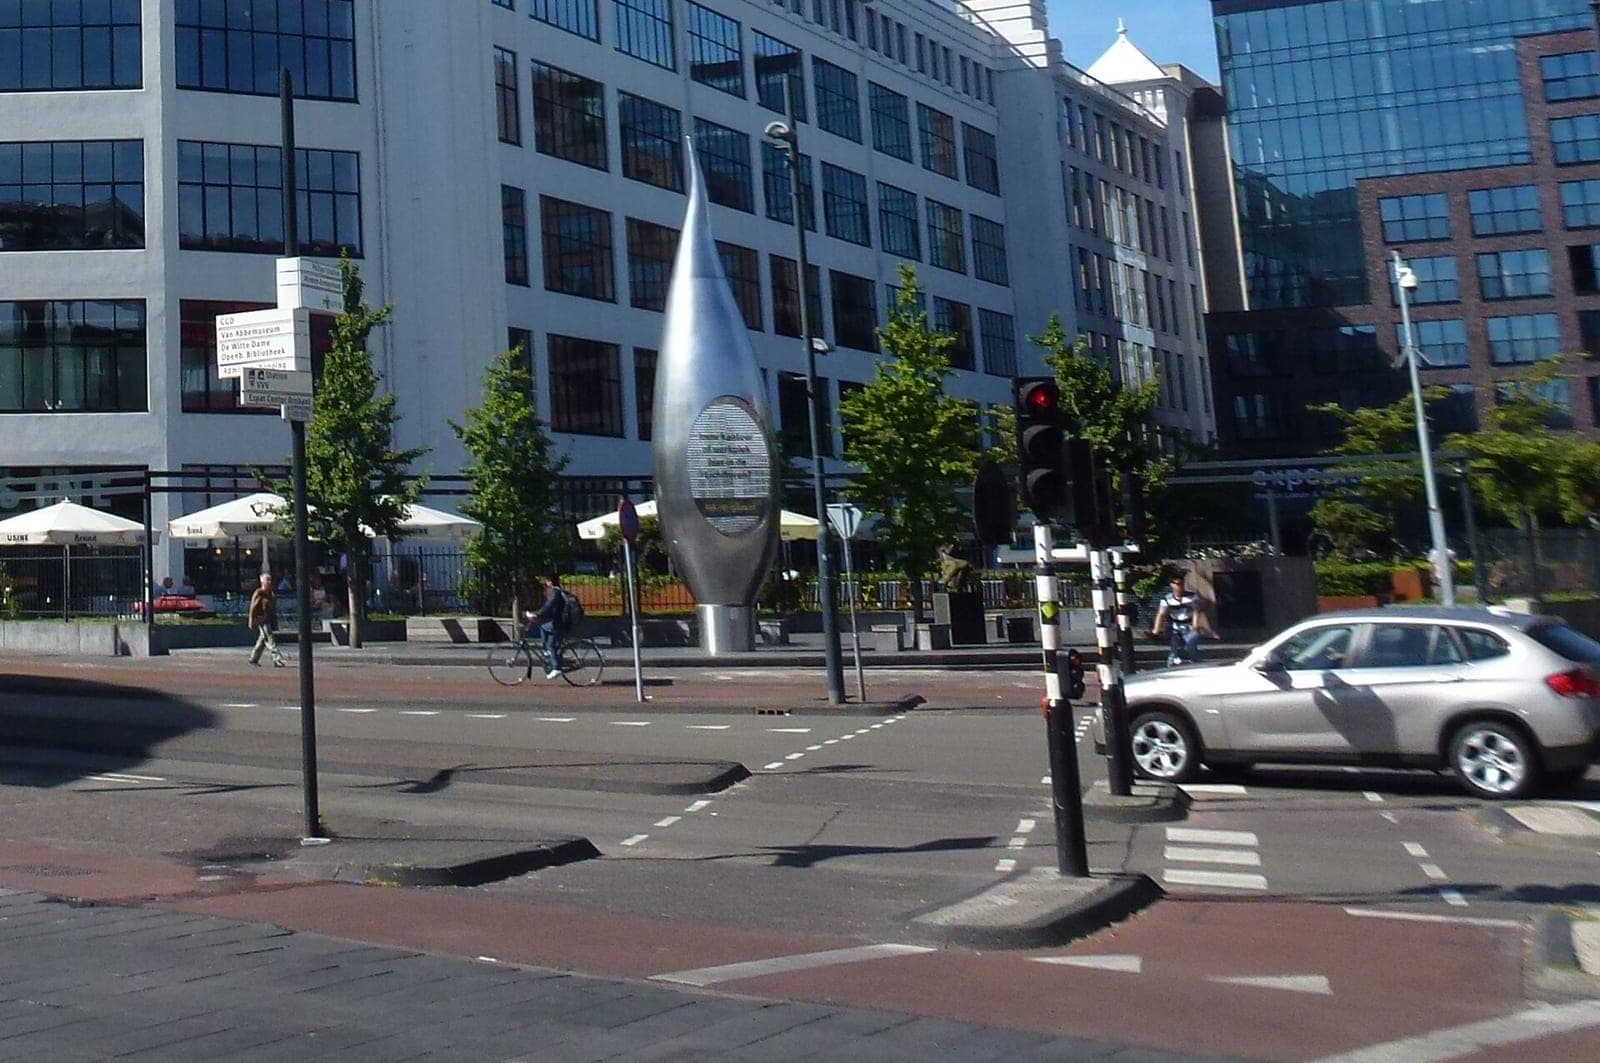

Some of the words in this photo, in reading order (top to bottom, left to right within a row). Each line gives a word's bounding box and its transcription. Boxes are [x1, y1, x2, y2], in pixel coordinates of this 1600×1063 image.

[221, 330, 233, 339] Van
[235, 326, 280, 336] Abbemuseum
[221, 343, 229, 351] De
[231, 342, 249, 350] Witte
[251, 340, 271, 348] Dame
[246, 347, 286, 358] Bibliotheek
[6, 534, 29, 542] USINE
